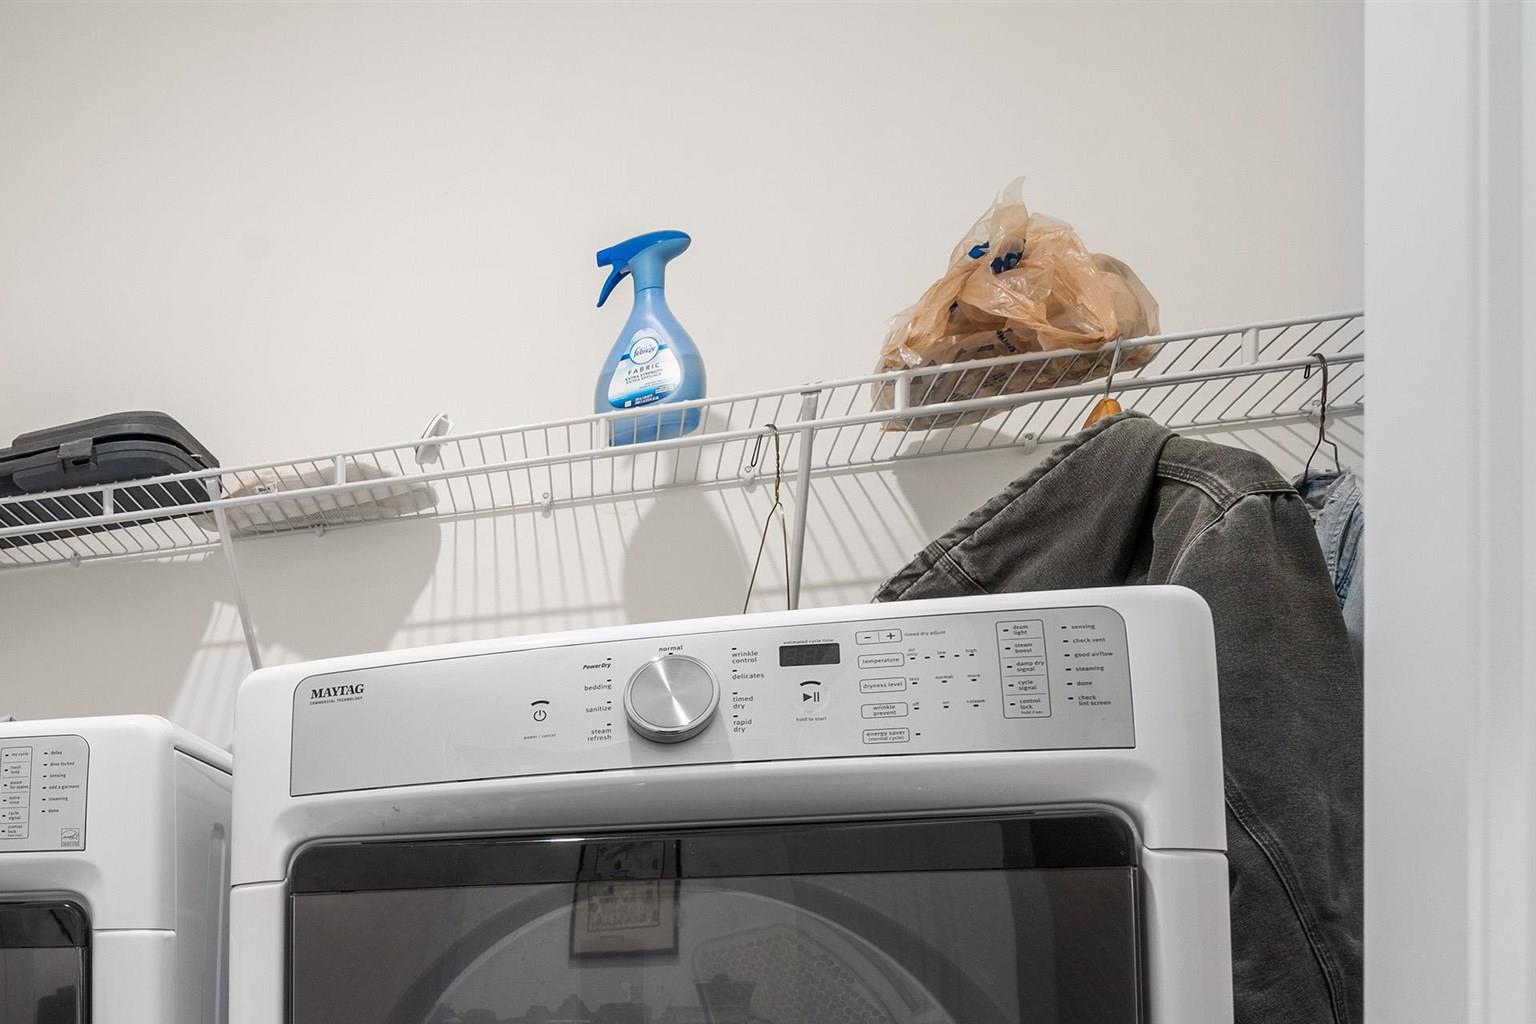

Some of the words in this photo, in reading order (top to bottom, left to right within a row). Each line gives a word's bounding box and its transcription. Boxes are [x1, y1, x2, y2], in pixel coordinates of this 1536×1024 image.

[627, 362, 661, 375] FABRIC
[862, 657, 899, 665] temperature
[582, 662, 612, 670] PowerDry
[732, 672, 765, 680] delicates
[311, 684, 364, 699] MAYTAG
[584, 683, 612, 692] bedding
[585, 705, 612, 713] sanitize
[587, 734, 612, 742] refresh
